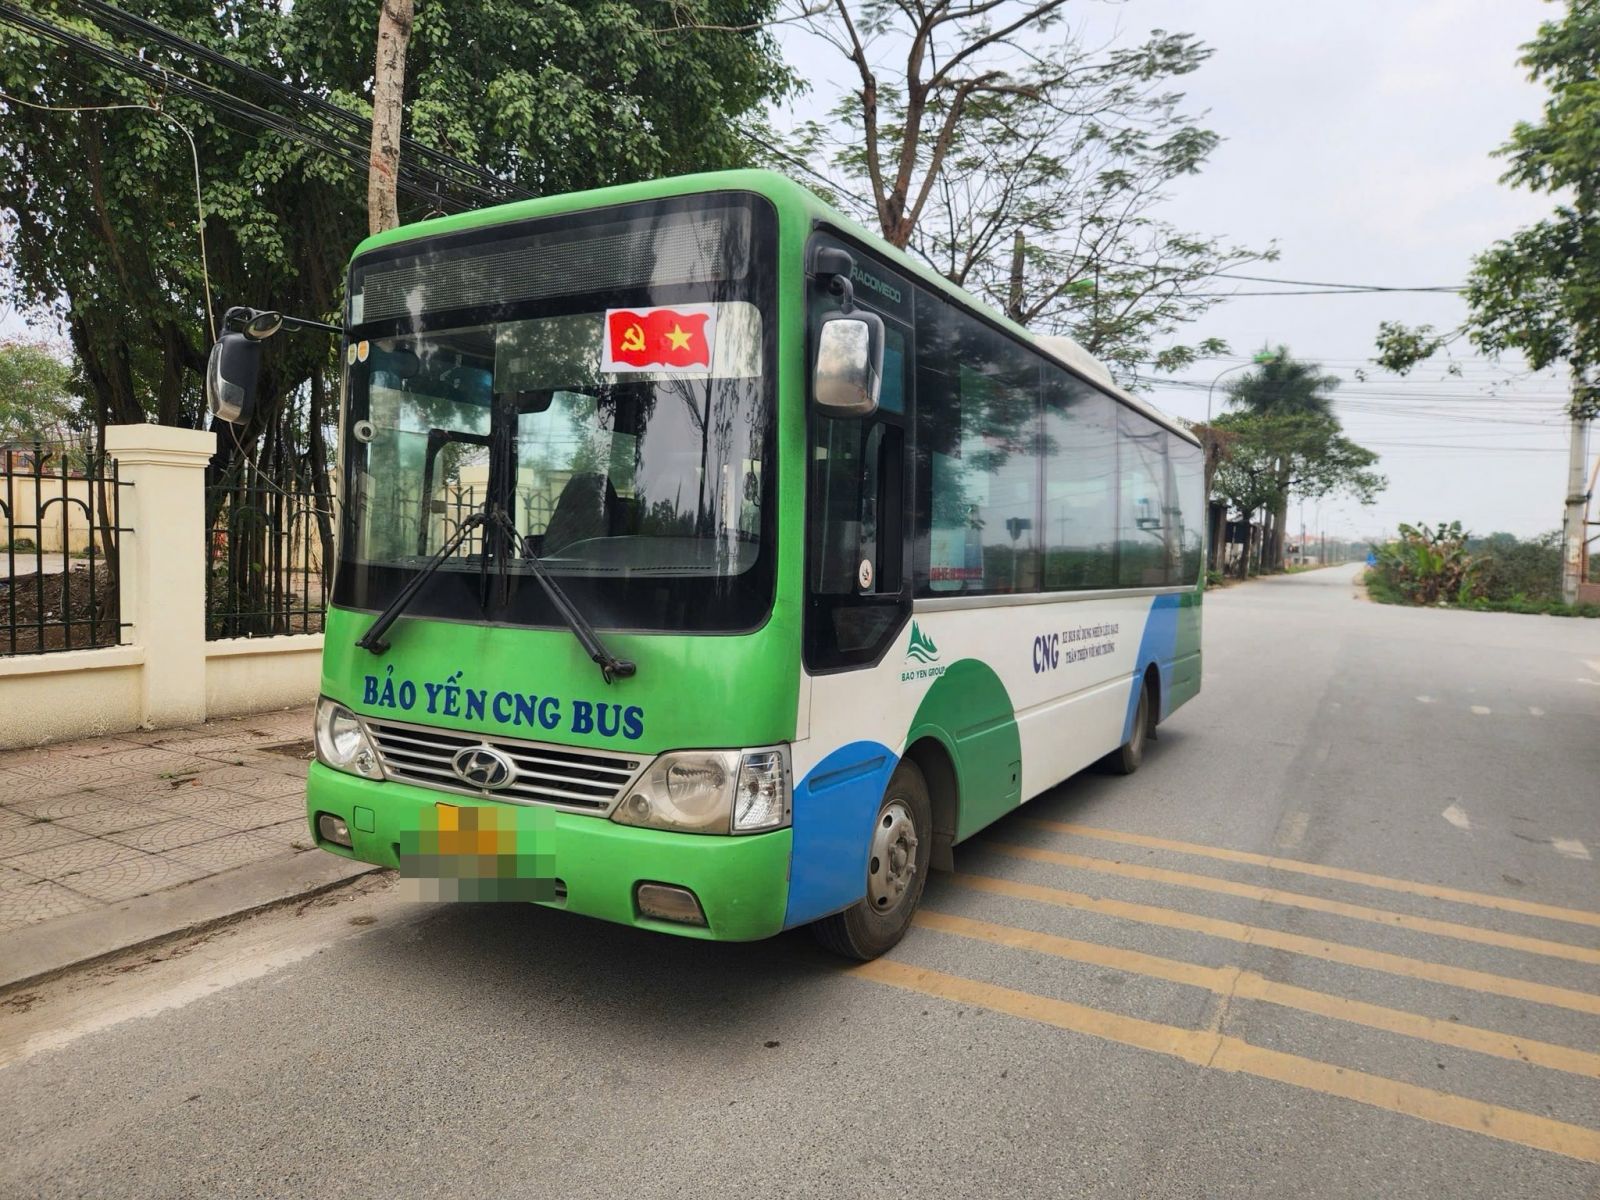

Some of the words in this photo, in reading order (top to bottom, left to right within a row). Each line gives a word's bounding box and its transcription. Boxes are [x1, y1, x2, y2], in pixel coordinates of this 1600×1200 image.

[850, 261, 901, 303] RACOMECO
[901, 671, 914, 681] BAO
[915, 669, 927, 679] YEN
[928, 666, 946, 677] GROUP
[1033, 633, 1059, 674] CNG
[363, 665, 417, 710] BẢO
[425, 670, 488, 722] YẾN
[492, 691, 562, 730] CNG
[571, 700, 644, 740] BUS
